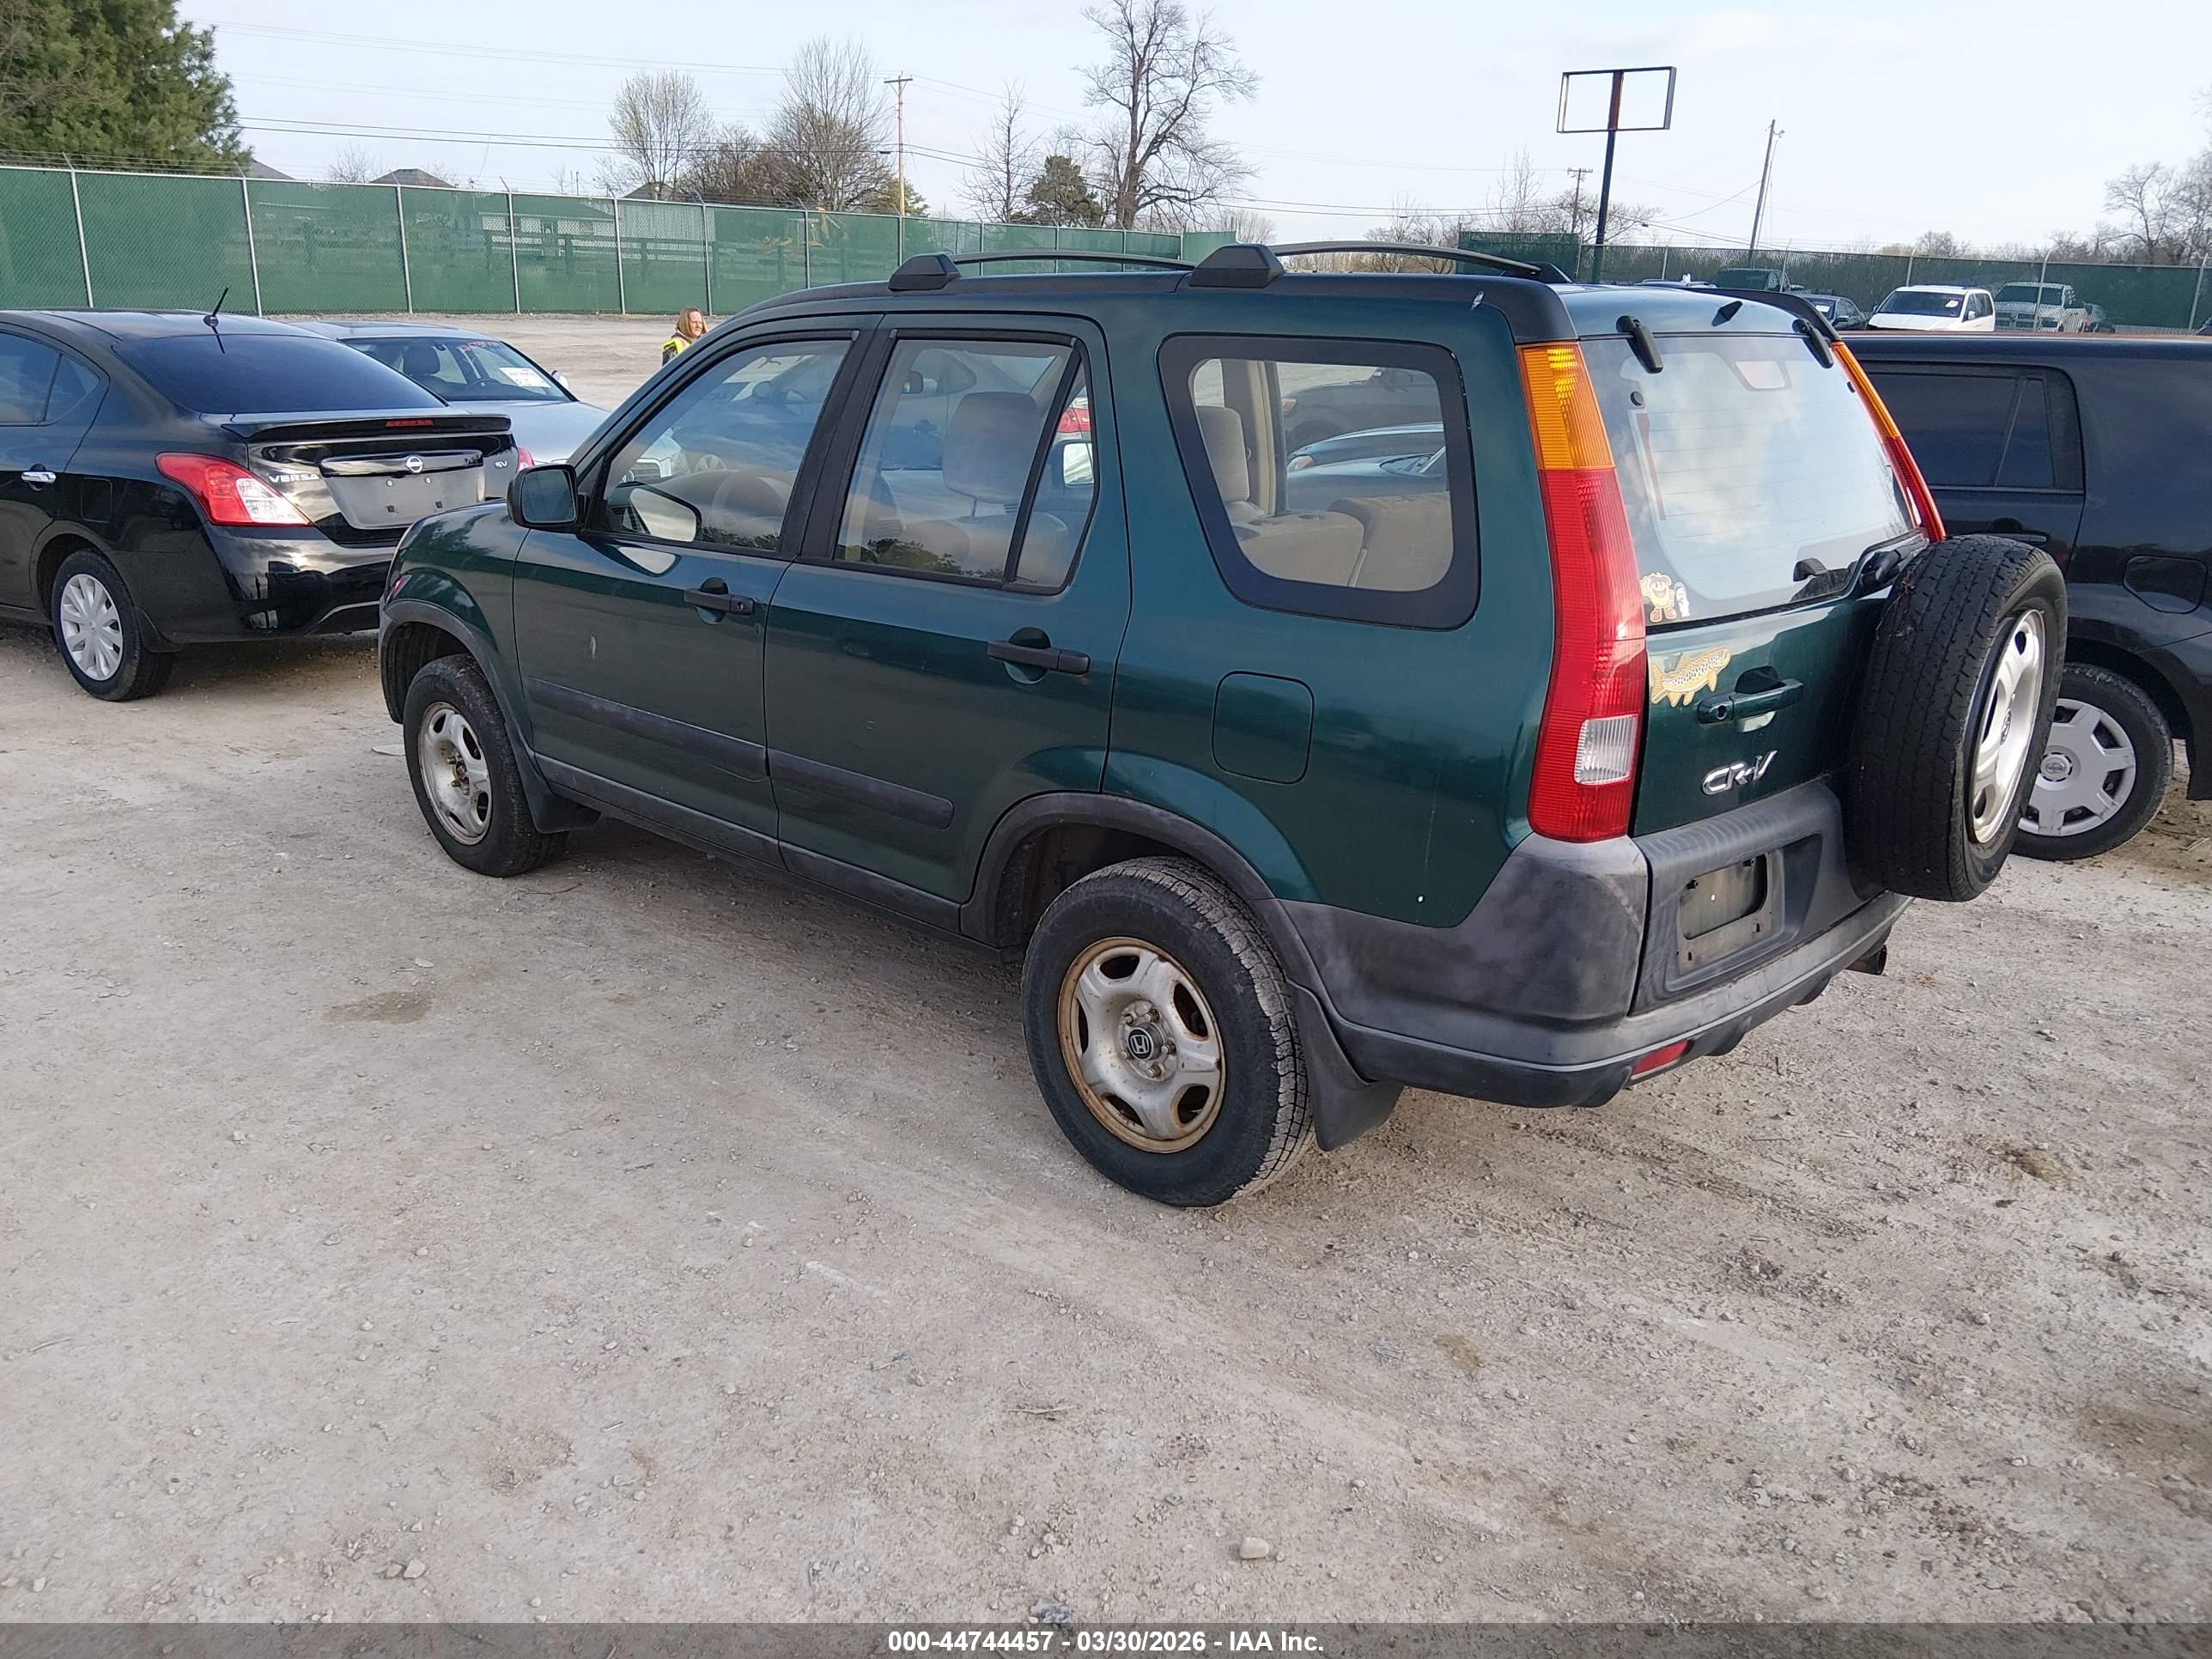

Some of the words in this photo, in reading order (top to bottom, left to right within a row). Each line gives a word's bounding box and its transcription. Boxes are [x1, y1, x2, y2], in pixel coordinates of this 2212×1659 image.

[495, 459, 507, 468] SV
[268, 473, 319, 483] VERSA
[1702, 750, 1778, 795] CR-V
